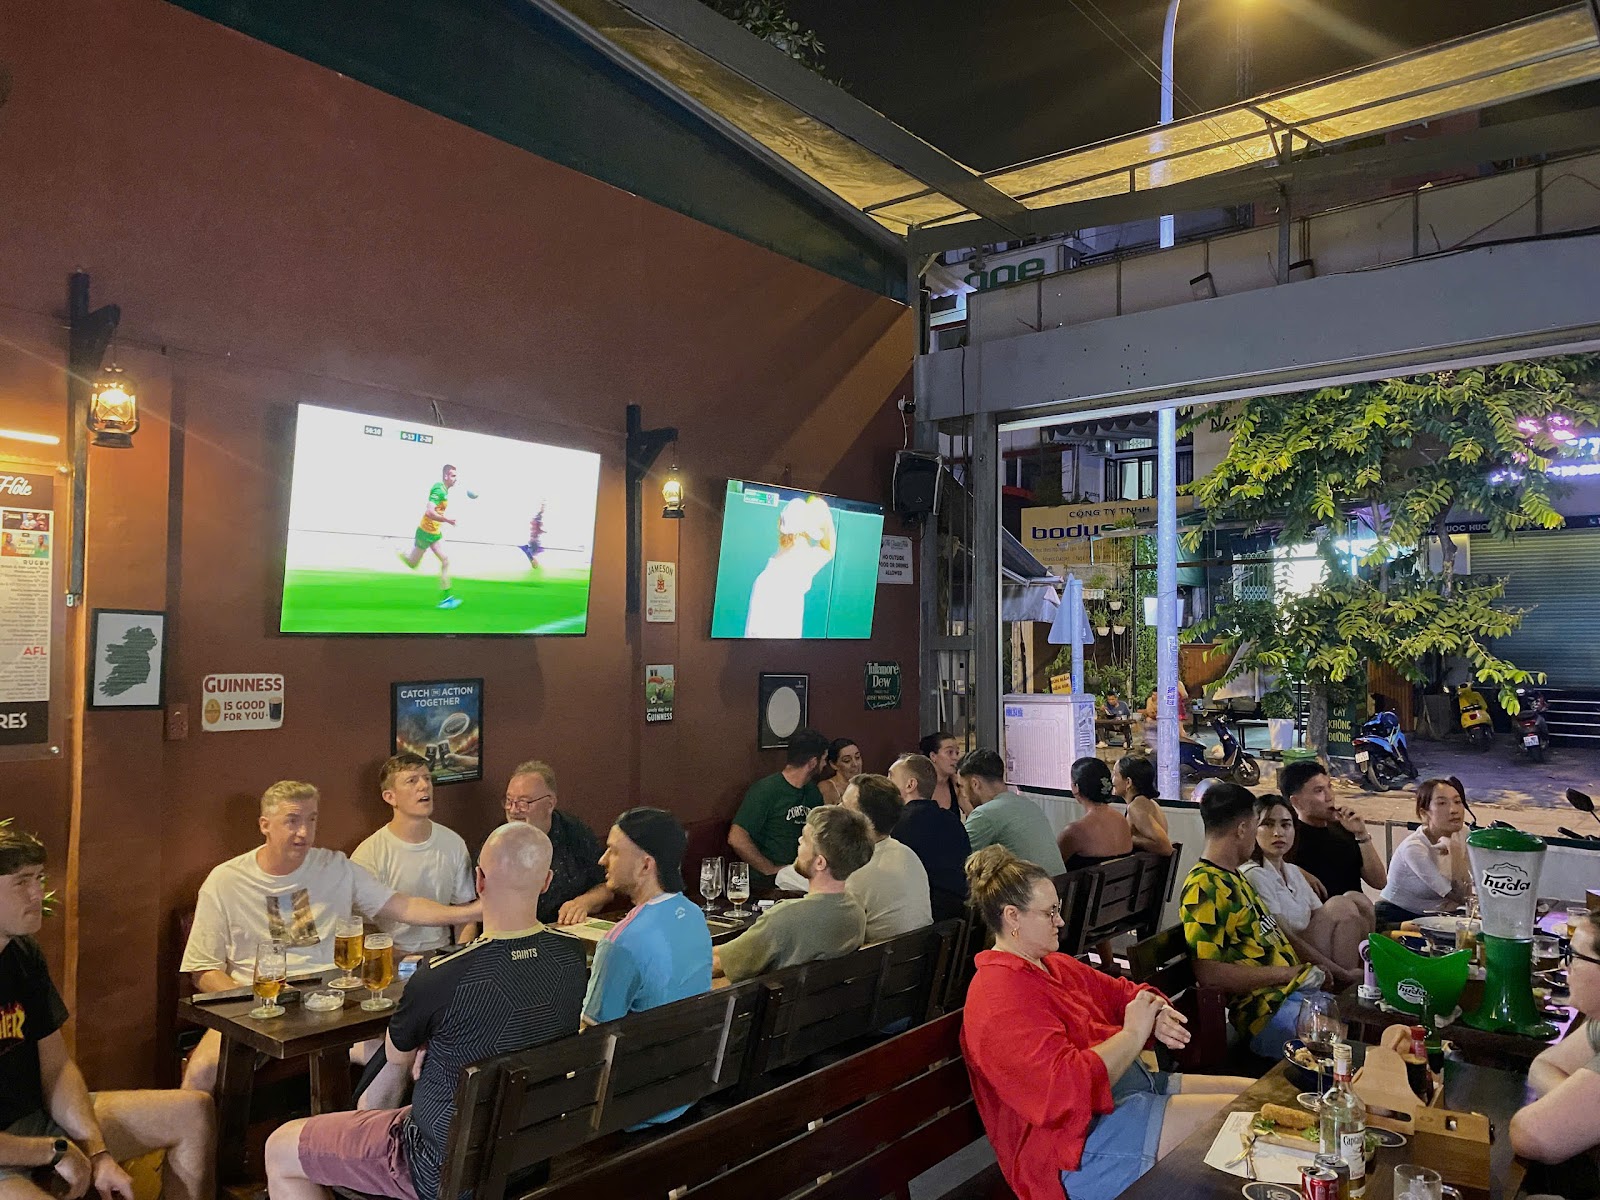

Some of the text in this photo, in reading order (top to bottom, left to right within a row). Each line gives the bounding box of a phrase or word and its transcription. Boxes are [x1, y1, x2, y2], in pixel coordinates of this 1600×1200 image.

[647, 564, 674, 577] JAMESON
[23, 646, 47, 655] AFL
[204, 676, 282, 694] GUINNESS
[872, 674, 892, 688] Dew
[400, 689, 430, 699] CATCH
[441, 686, 474, 697] ACTION
[223, 700, 266, 711] IS GOOD
[414, 696, 460, 708] TOGETHER
[223, 712, 242, 722] FOR
[647, 713, 673, 722] GUINNESS
[1484, 873, 1531, 892] huda
[511, 947, 538, 961] SAINTS
